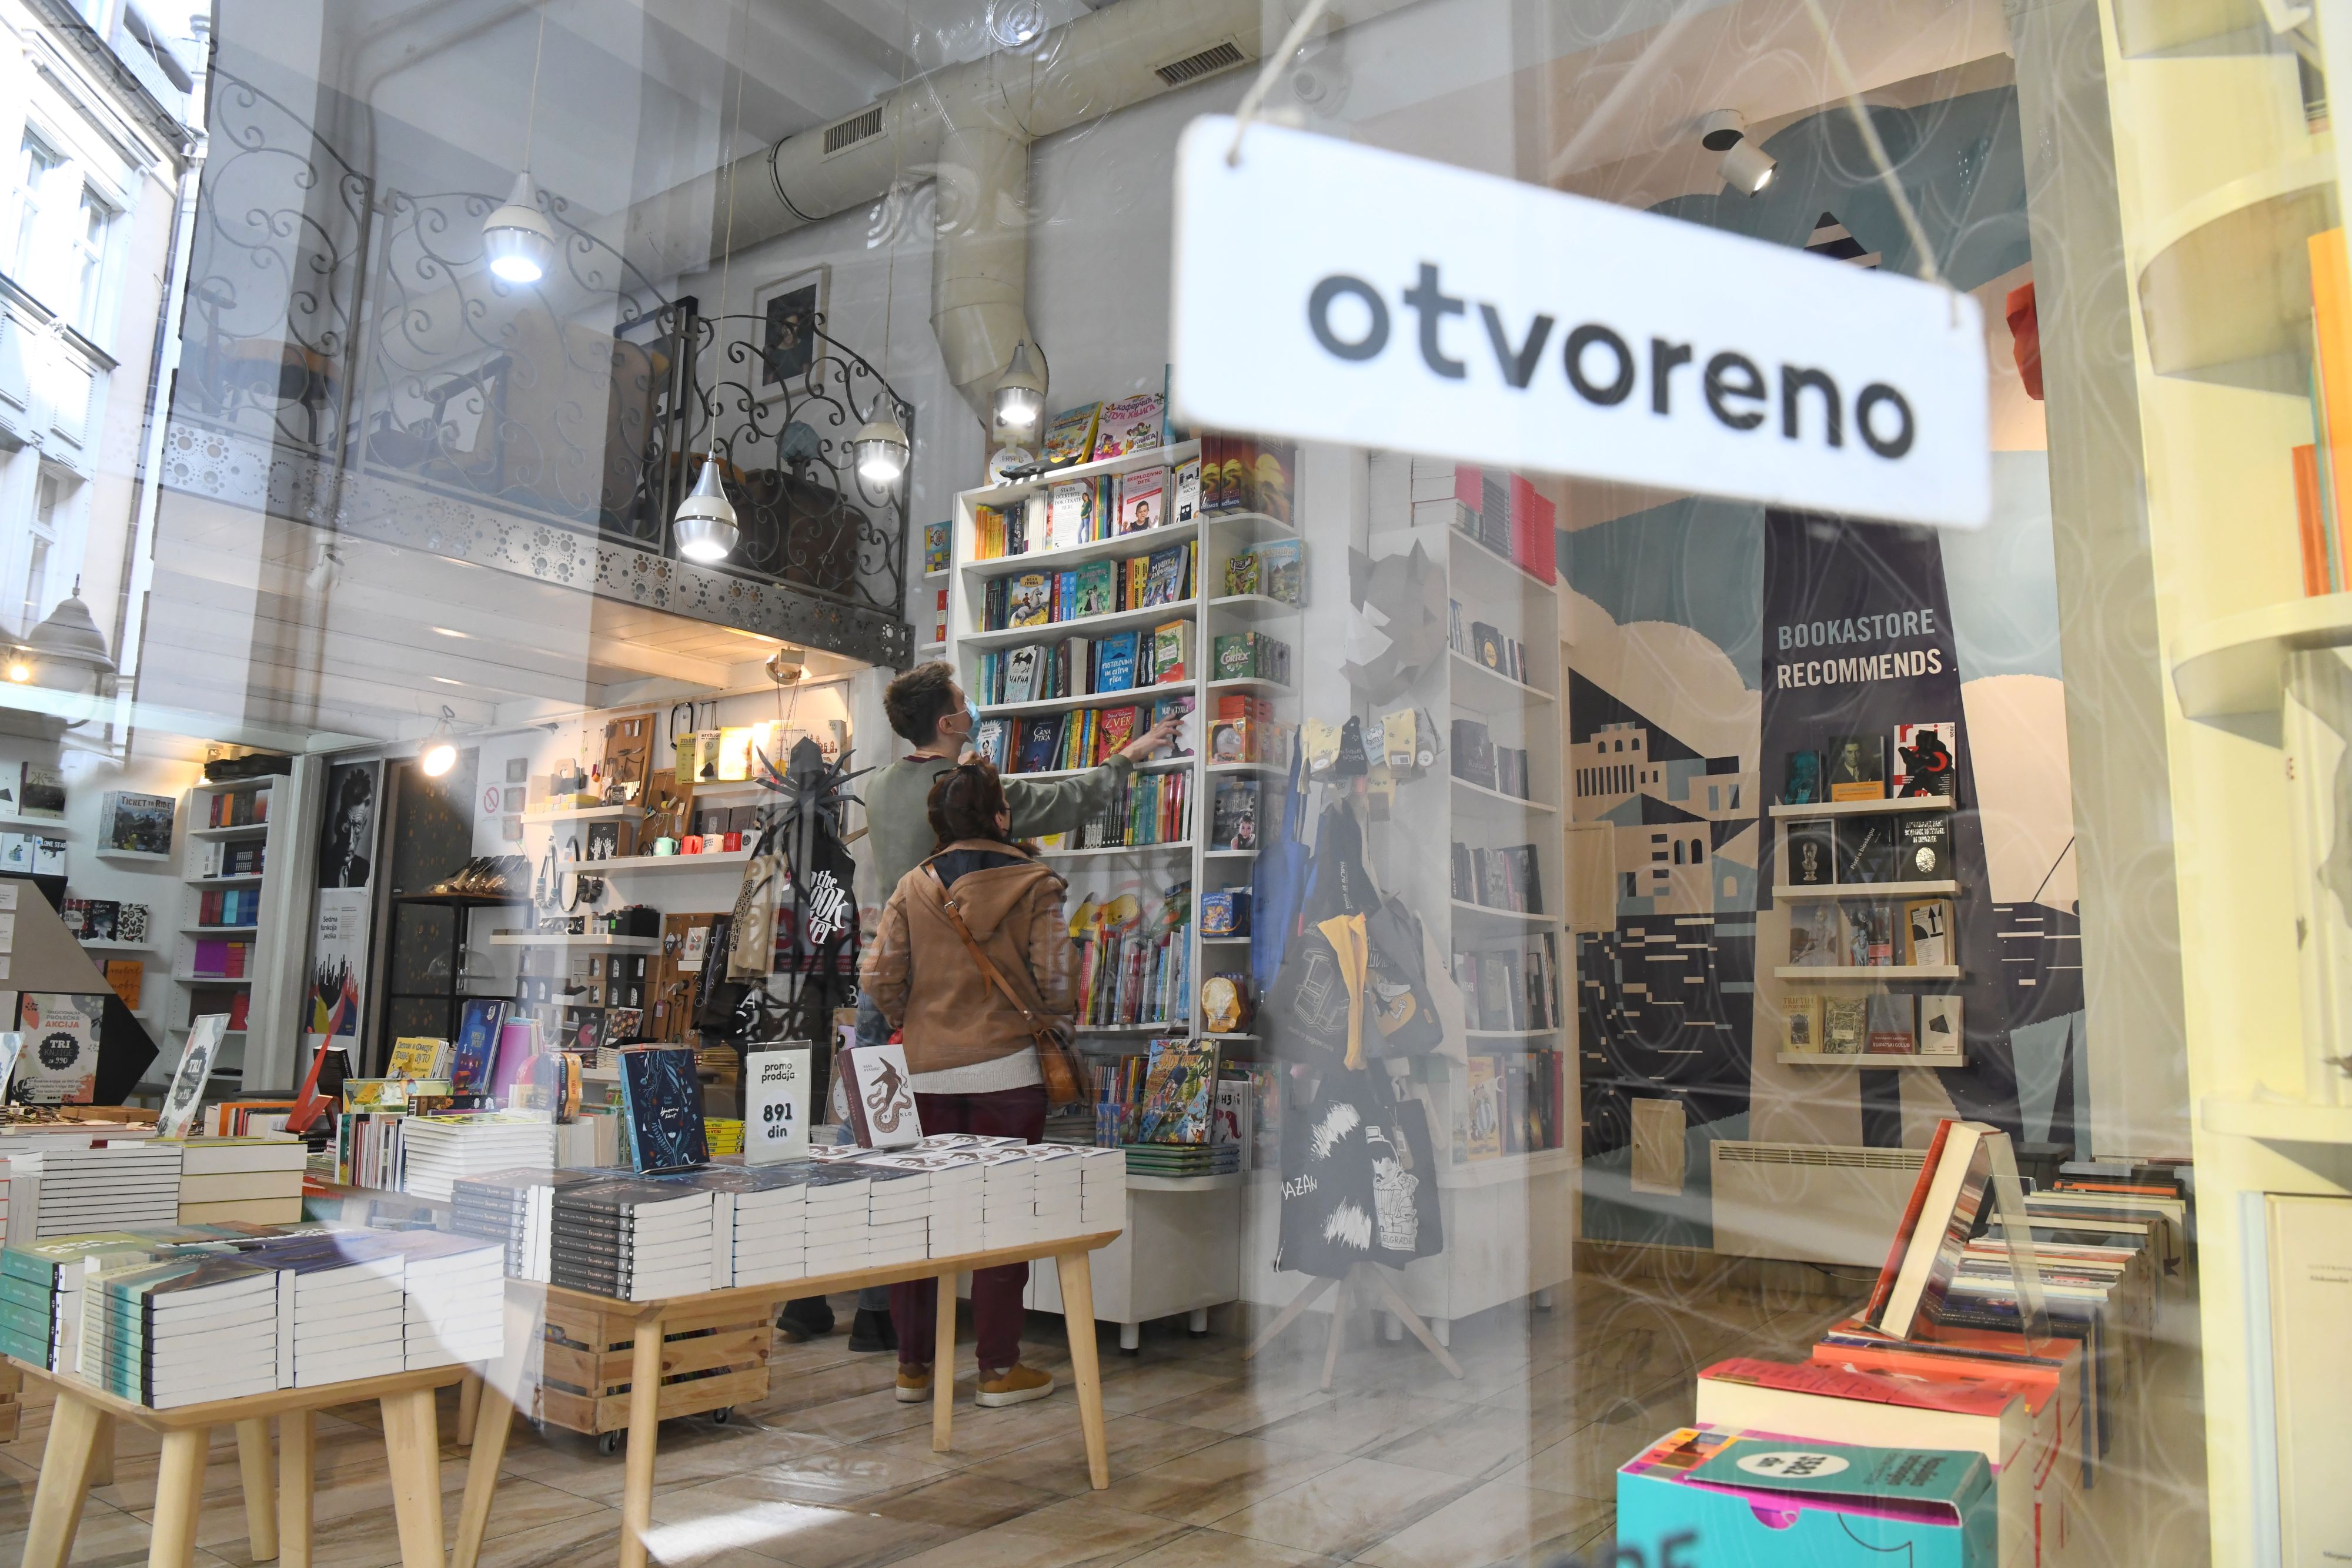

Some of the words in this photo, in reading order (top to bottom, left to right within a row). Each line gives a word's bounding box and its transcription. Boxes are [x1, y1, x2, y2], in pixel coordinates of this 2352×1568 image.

[1307, 260, 1915, 461] otvoreno
[1127, 470, 1162, 482] EKSPLOZIVNO
[1055, 491, 1080, 499] OČEKUJETE
[1778, 609, 1935, 650] BOOKASTORE
[1102, 658, 1132, 669] PUSTOLOVINA
[1777, 648, 1942, 689] RECOMMENDS
[1111, 667, 1128, 676] ostrvu
[1109, 677, 1122, 686] ptica
[1162, 706, 1171, 715] МАР
[1175, 706, 1189, 714] ХУАНА
[1105, 716, 1132, 729] ZVER
[1034, 727, 1051, 735] CRNA
[121, 796, 146, 807] TICKET
[155, 800, 172, 810] RIDE
[1850, 856, 1859, 870] Pisci
[1859, 828, 1875, 852] bioskopu
[817, 870, 838, 889] the
[810, 885, 849, 929] ook
[49, 1039, 71, 1048] TRI
[44, 1049, 73, 1057] KNJIGE
[188, 1059, 202, 1073] TRI
[764, 1062, 793, 1073] promo
[761, 1071, 795, 1084] prodaja
[763, 1102, 793, 1124] 891
[875, 1111, 913, 1121] PORIJEKLO
[767, 1124, 787, 1139] din
[54, 1271, 58, 1280] 40
[52, 1300, 55, 1308] 40
[51, 1326, 54, 1335] 40
[49, 1353, 52, 1362] 40
